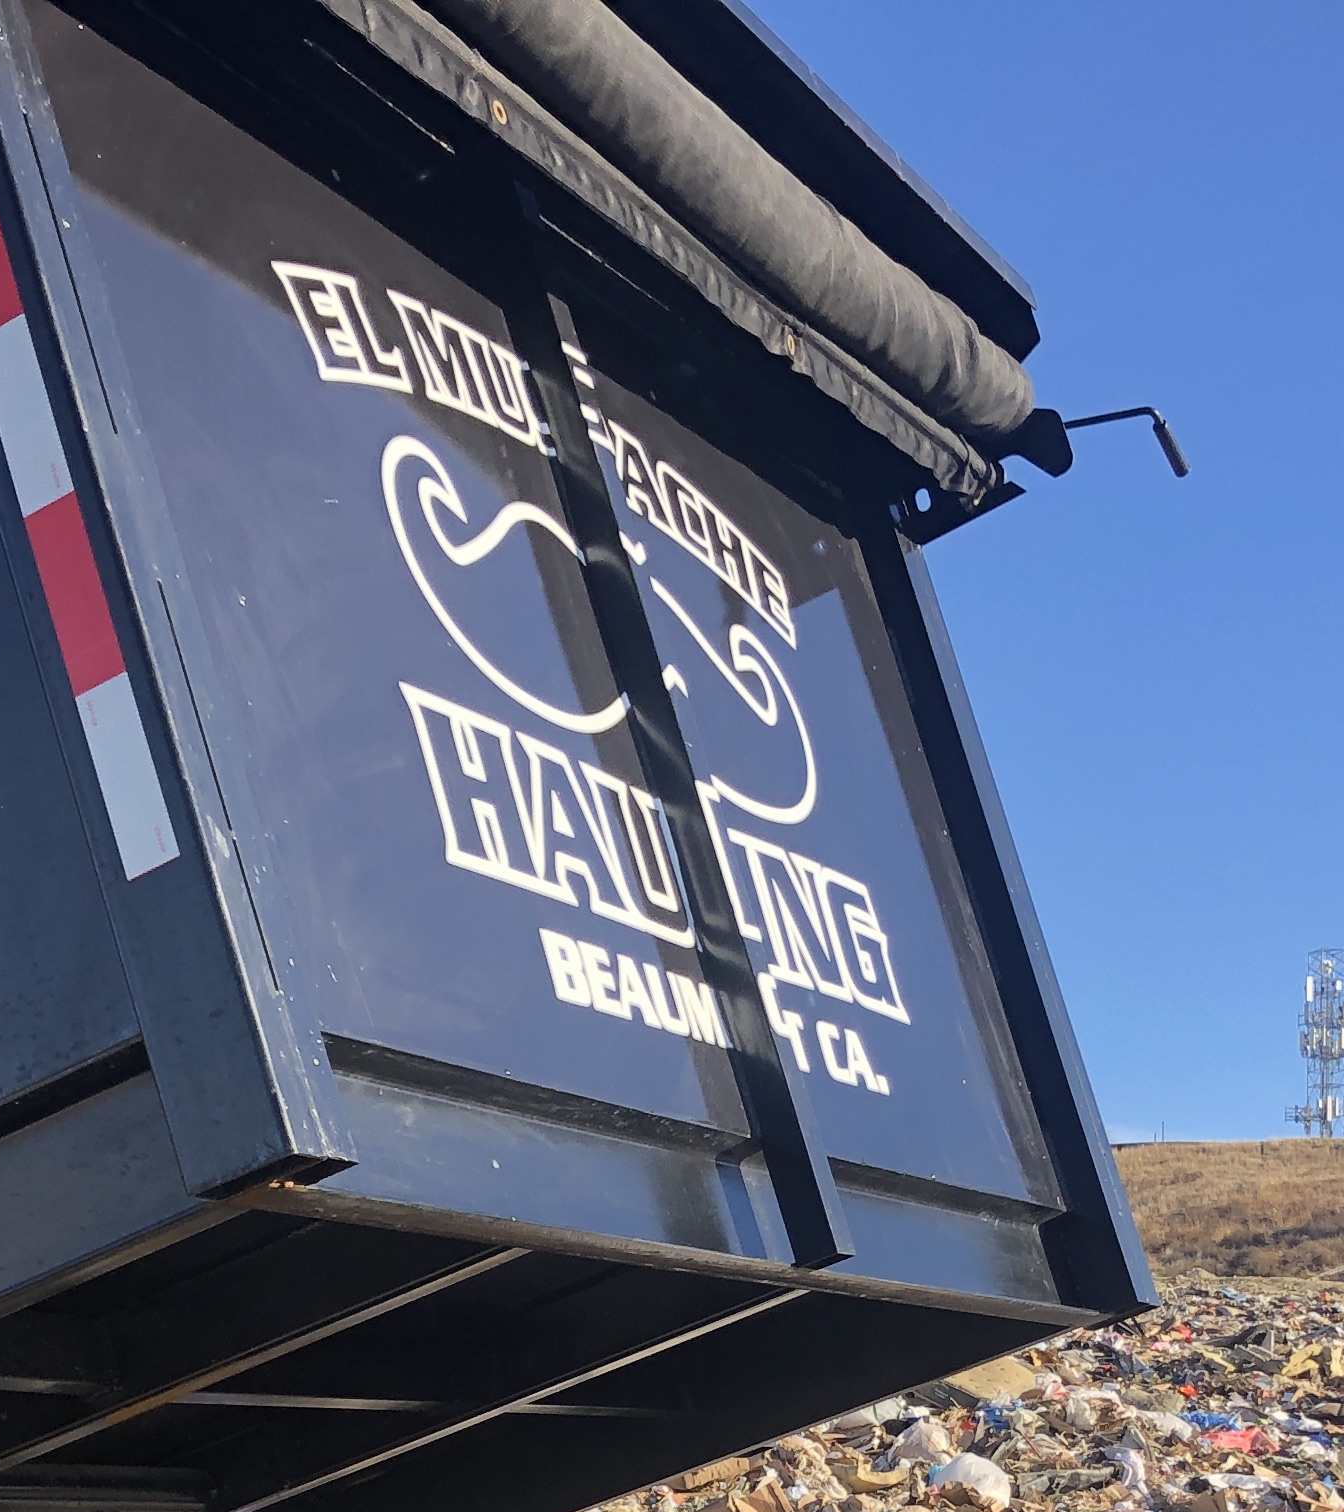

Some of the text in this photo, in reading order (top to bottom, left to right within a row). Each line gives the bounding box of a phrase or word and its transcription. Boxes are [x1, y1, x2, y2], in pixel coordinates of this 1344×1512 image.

[270, 260, 797, 651] EL MUACHE
[398, 681, 911, 1025] HAUING
[538, 927, 811, 1074] BEAUMT
